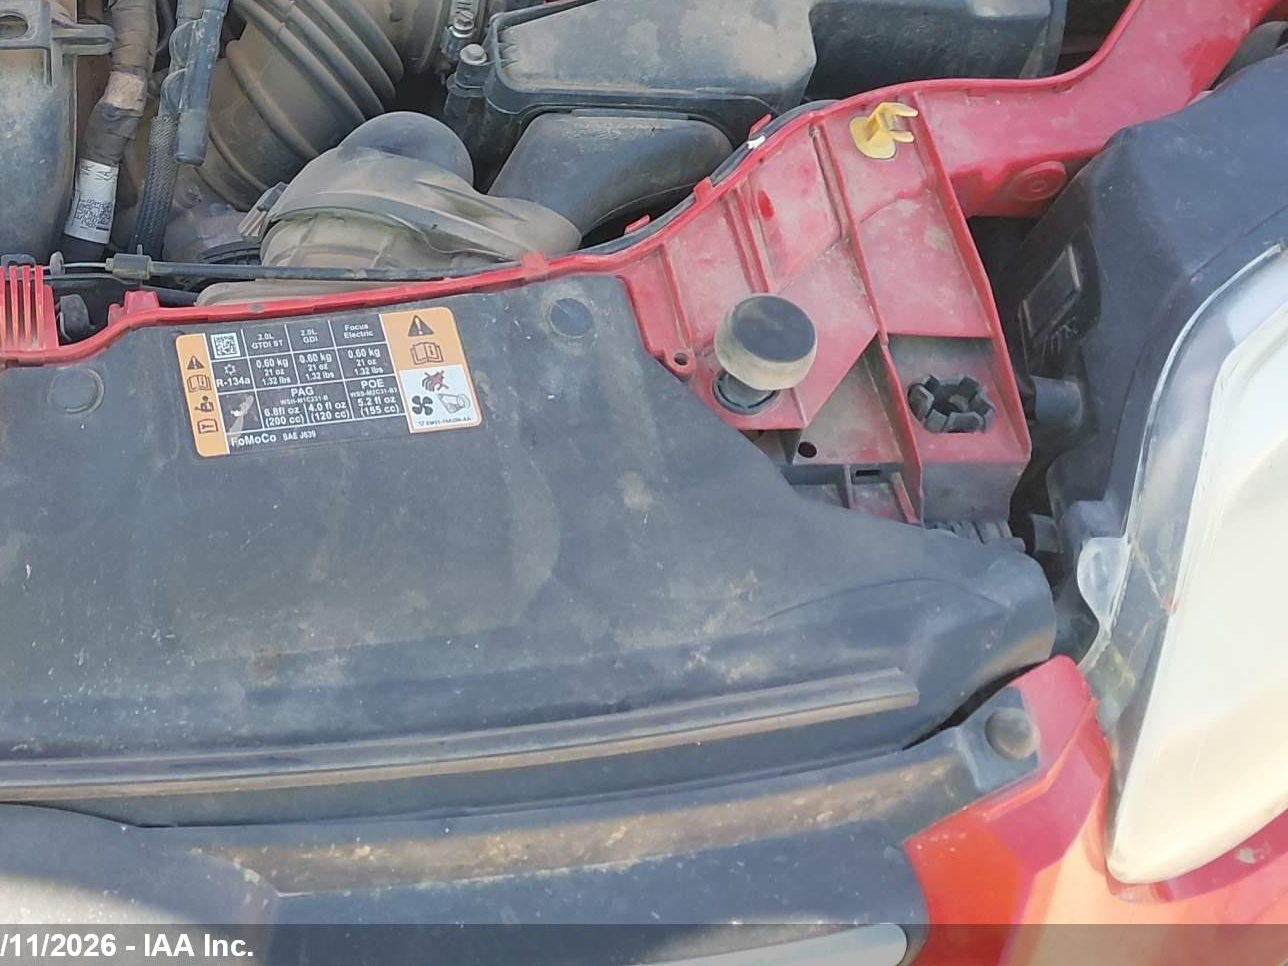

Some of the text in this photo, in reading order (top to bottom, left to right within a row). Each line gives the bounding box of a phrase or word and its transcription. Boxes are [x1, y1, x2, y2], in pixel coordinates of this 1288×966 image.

[300, 328, 317, 336] 2.0L
[344, 323, 369, 331] Focus
[257, 333, 275, 341] 2.0L
[343, 330, 374, 339] Electric
[251, 339, 284, 349] GTDI ST
[302, 336, 318, 344] GDI
[299, 352, 332, 363] 0.60 kg
[368, 347, 381, 358] kg
[255, 357, 289, 368] 0.60 kg
[355, 358, 377, 367] 21 oz
[264, 369, 273, 377] 21
[307, 364, 317, 372] 21
[354, 366, 384, 376] 1.32 lbs
[262, 376, 291, 386] 1.32 lbs
[305, 371, 334, 381] 1.32 lbs
[216, 376, 251, 388] R-134a
[360, 379, 385, 389] POE
[290, 386, 314, 397] PAG
[308, 401, 347, 412] 4.0 fl oz
[357, 396, 397, 407] 5.2 fl oz
[288, 406, 300, 414] oz
[360, 403, 400, 418] (155 cc)
[265, 414, 304, 428] (200 cc)
[311, 409, 350, 423] (120 cc)
[230, 433, 277, 447] FoMoCo
[282, 432, 298, 441] SAE
